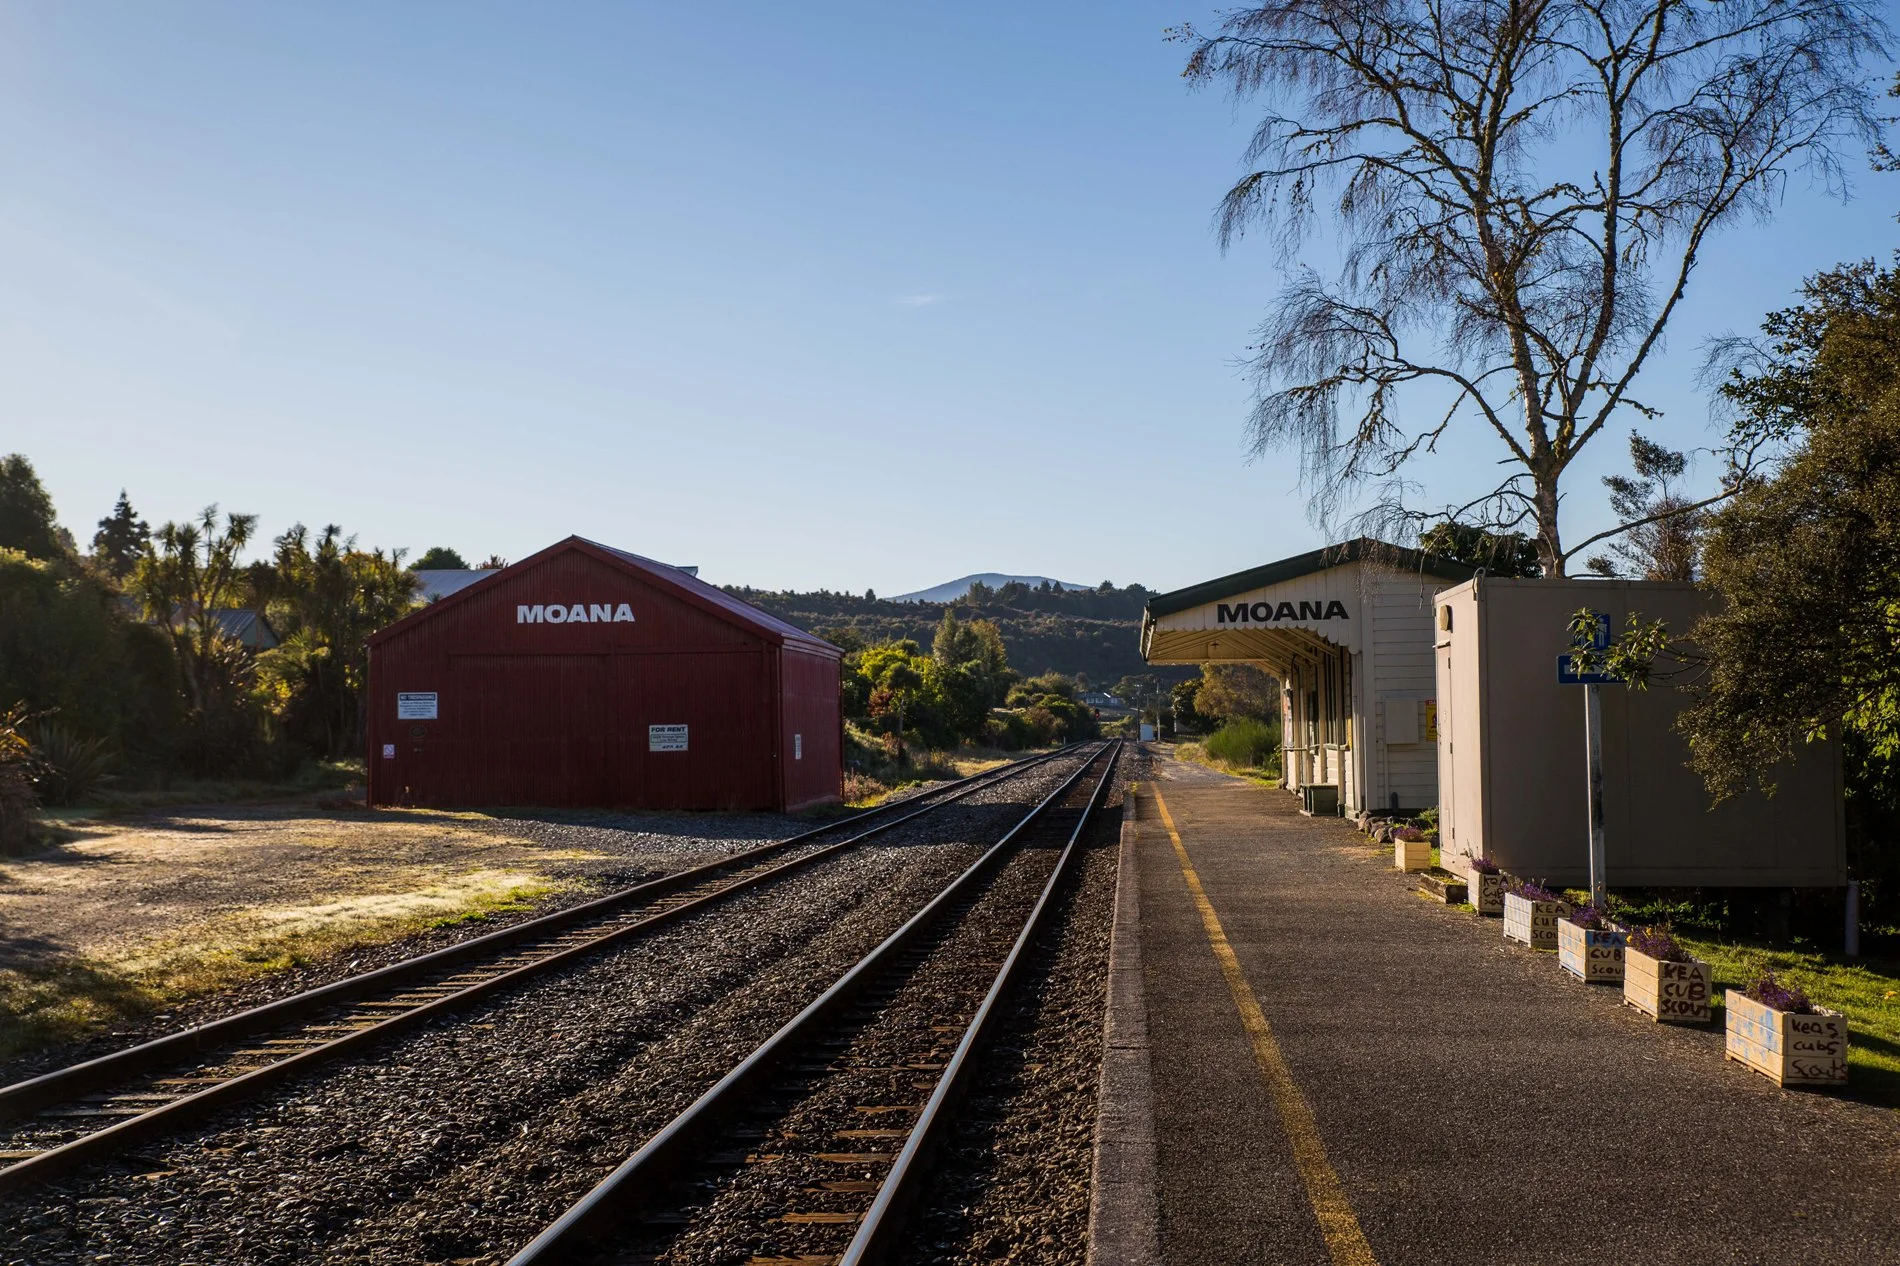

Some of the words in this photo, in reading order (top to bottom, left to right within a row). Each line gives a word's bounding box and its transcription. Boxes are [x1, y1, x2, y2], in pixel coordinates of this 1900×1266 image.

[517, 603, 635, 623] MOANA
[1217, 600, 1350, 623] MOANA
[1535, 903, 1566, 914] KEA
[1532, 929, 1558, 940] SCOU
[1592, 931, 1624, 945] KEA
[1591, 964, 1624, 975] SCOU
[1664, 963, 1704, 982] KEA
[1664, 982, 1706, 1001] CUB
